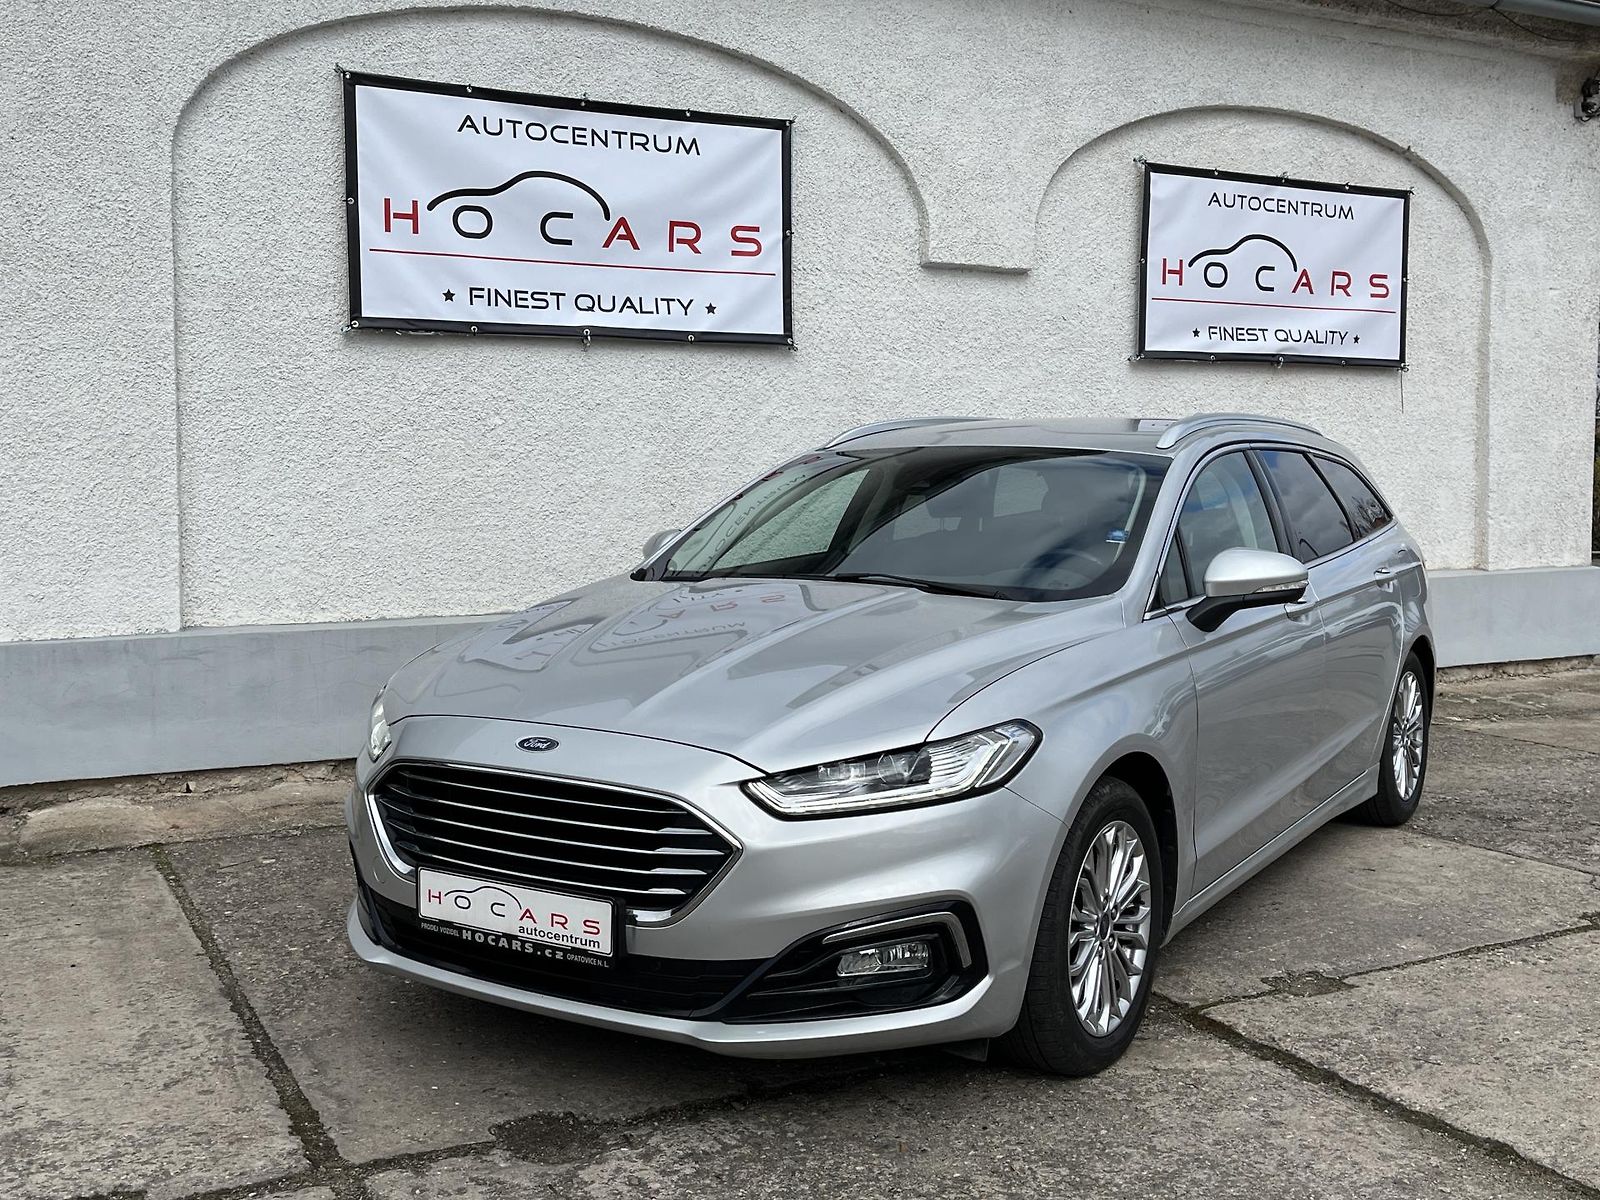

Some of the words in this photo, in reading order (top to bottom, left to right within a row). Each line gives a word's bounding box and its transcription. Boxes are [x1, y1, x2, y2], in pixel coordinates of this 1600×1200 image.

[457, 114, 701, 156] AUTOCENTRUM
[1207, 191, 1355, 220] AUTOCENTRUM
[468, 287, 566, 312] FINEST
[574, 293, 694, 316] QUALITY
[1207, 326, 1269, 342] FINEST
[1274, 329, 1349, 345] QUALITY
[523, 738, 552, 749] Ford
[518, 925, 601, 949] autocentrum
[566, 953, 597, 966] OPATOVICE
